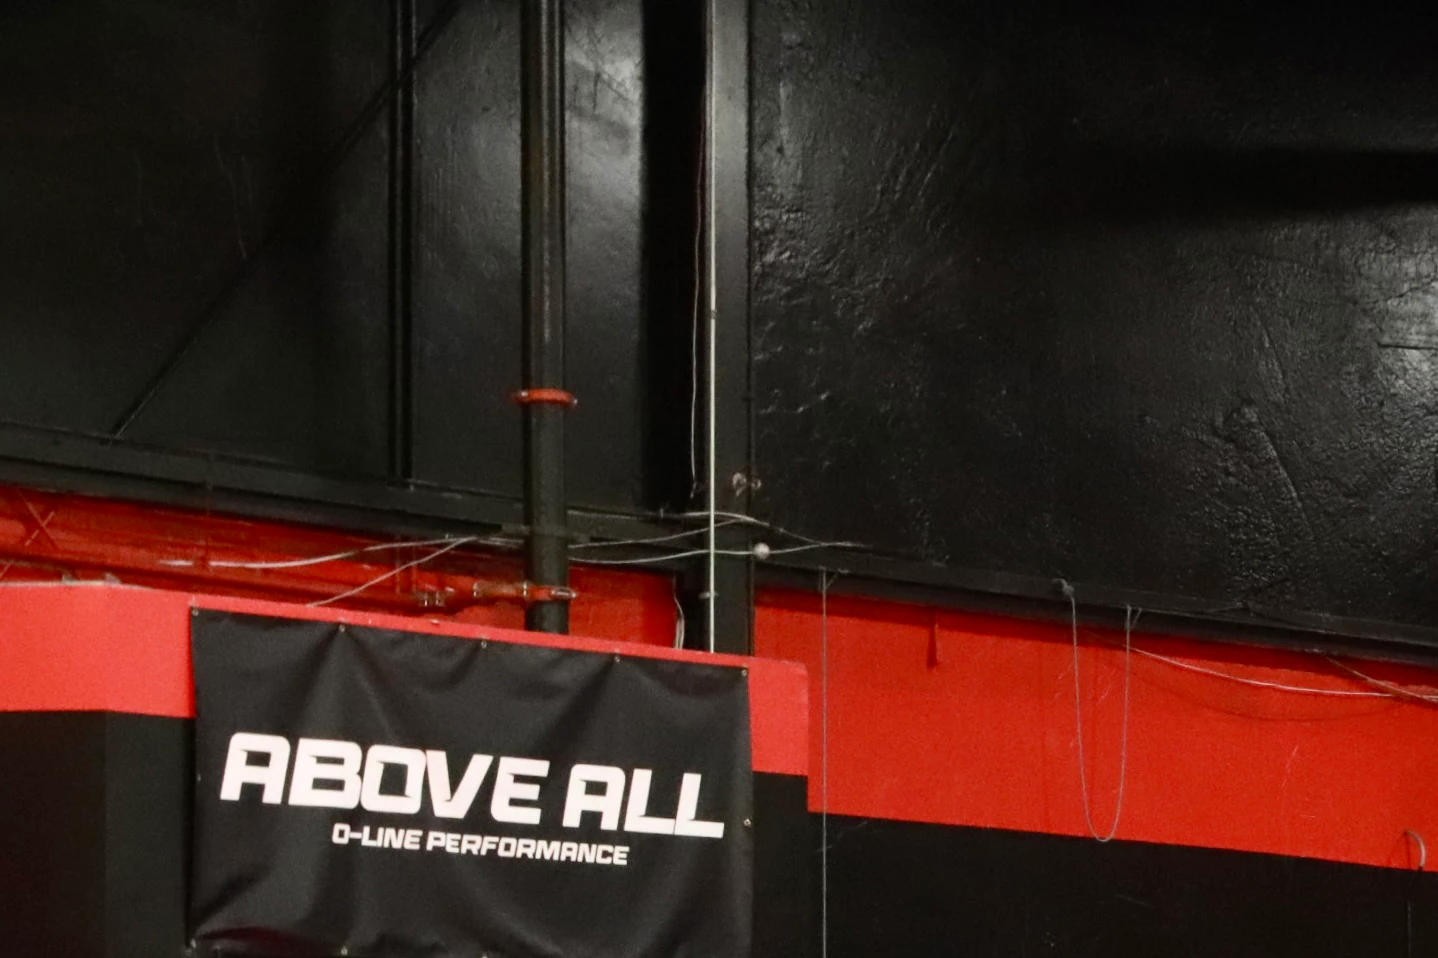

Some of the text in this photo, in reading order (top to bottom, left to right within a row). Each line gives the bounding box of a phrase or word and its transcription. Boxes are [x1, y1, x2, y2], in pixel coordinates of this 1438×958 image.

[220, 733, 725, 839] ABOVE ALL
[332, 823, 630, 866] O-LINE PERFORMANCE
